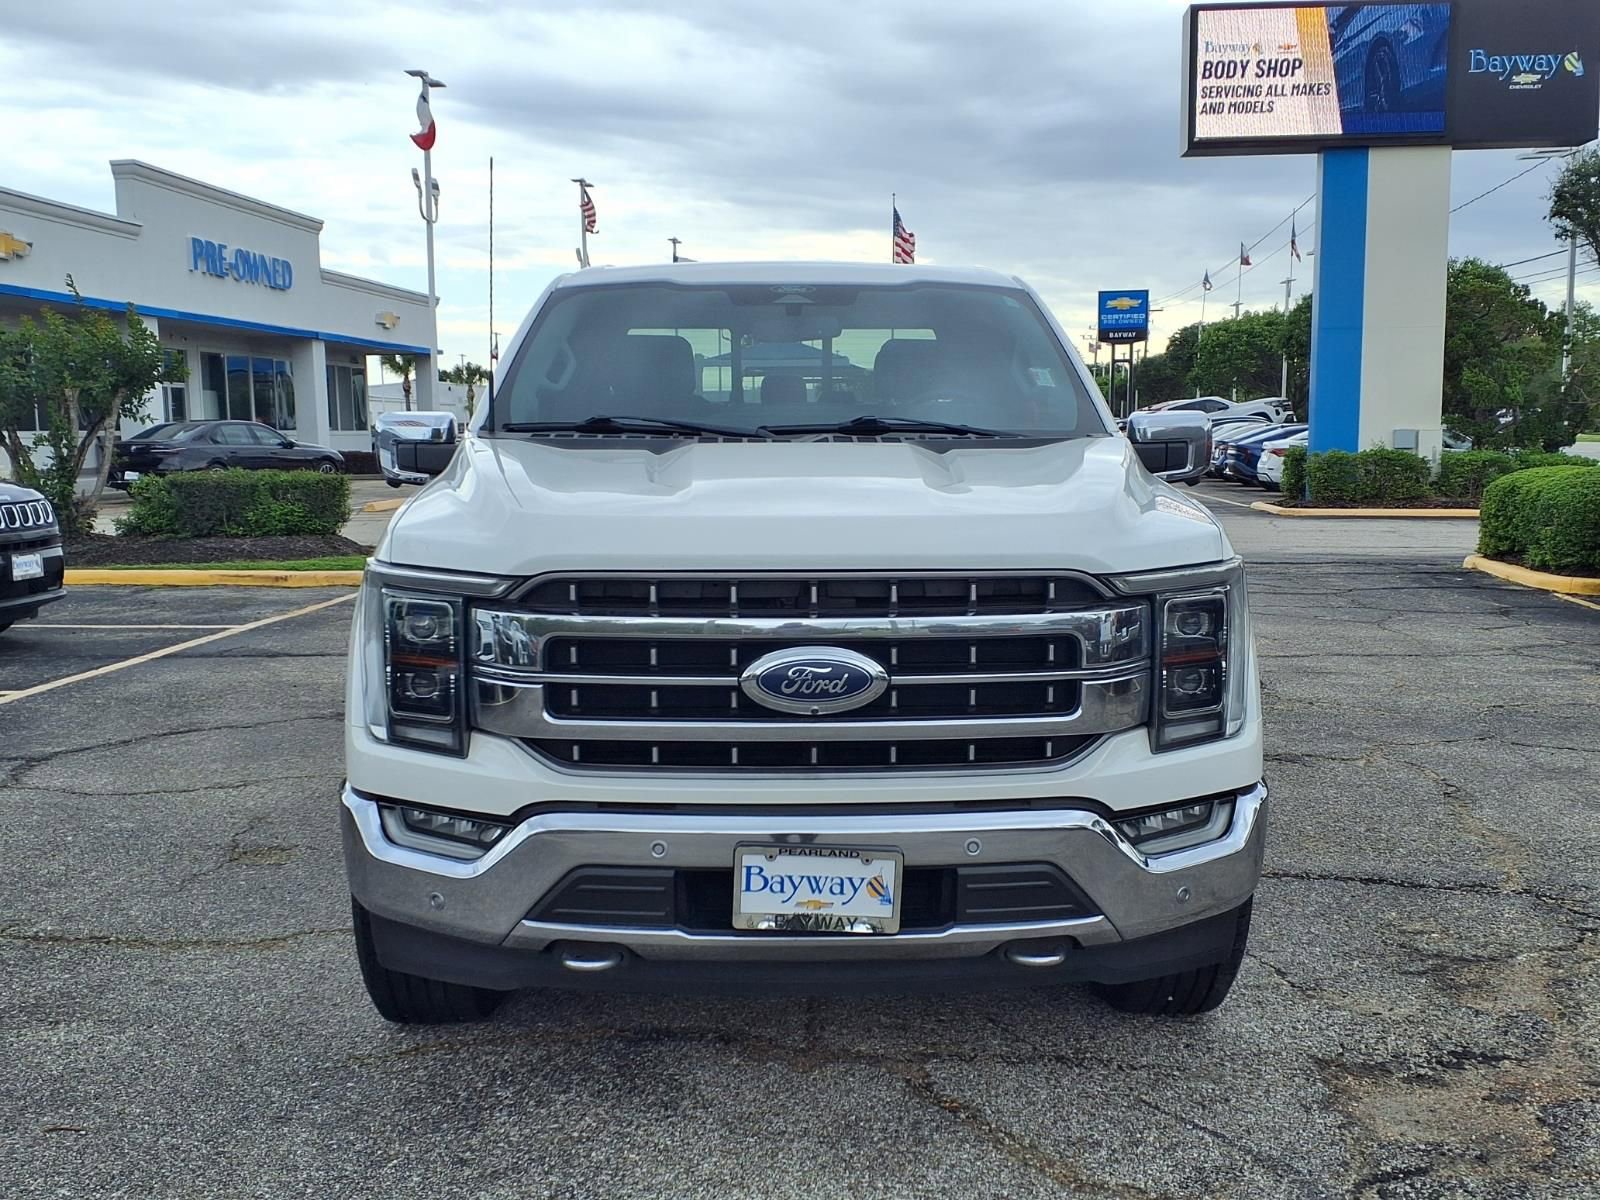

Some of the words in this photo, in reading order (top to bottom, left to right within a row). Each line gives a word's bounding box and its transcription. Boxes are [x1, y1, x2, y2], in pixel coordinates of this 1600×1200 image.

[1204, 41, 1251, 56] Bayway
[1201, 59, 1250, 79] BODY
[1255, 58, 1303, 78] SHOP
[1468, 49, 1562, 80] Bayway
[1201, 84, 1262, 99] SERVICING
[1265, 84, 1287, 97] ALL
[1291, 82, 1331, 97] MAKES
[1200, 101, 1225, 115] AND
[1228, 100, 1274, 114] MODELS
[191, 236, 293, 290] PRE-OWNED
[781, 666, 849, 694] Ford
[778, 848, 860, 858] PEARLAND
[742, 865, 866, 906] Bayway
